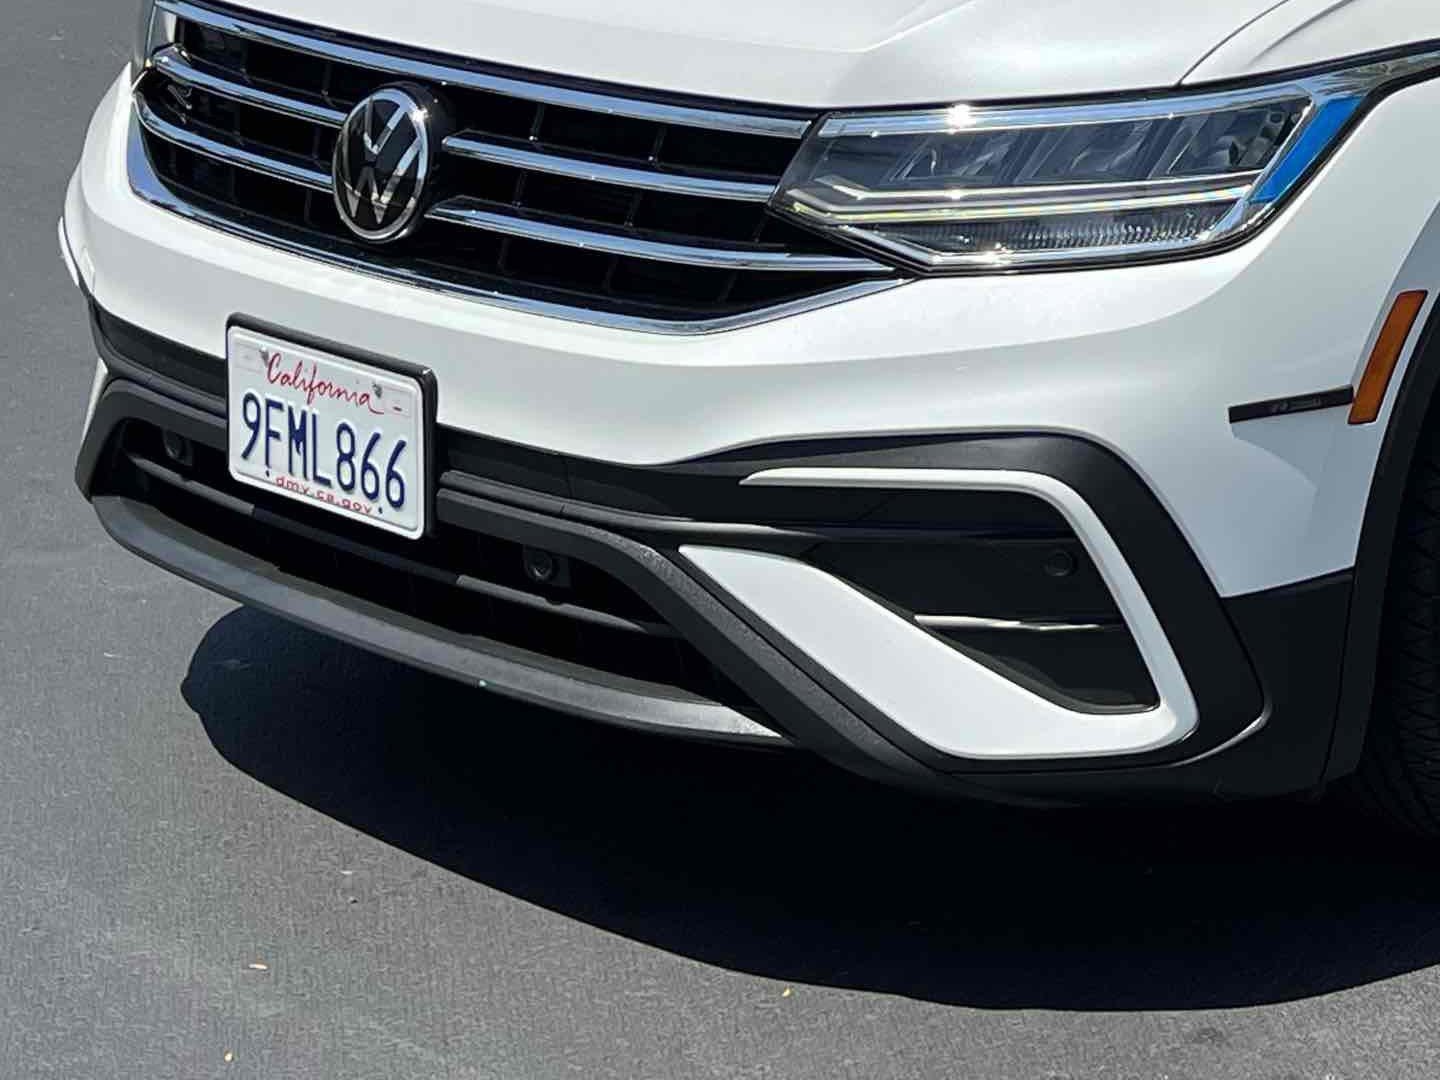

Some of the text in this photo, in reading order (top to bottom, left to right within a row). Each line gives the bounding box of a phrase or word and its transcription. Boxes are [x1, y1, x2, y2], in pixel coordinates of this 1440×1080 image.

[267, 351, 385, 415] California
[241, 391, 407, 509] 9FML866
[275, 475, 373, 515] dmv.ca.gov
